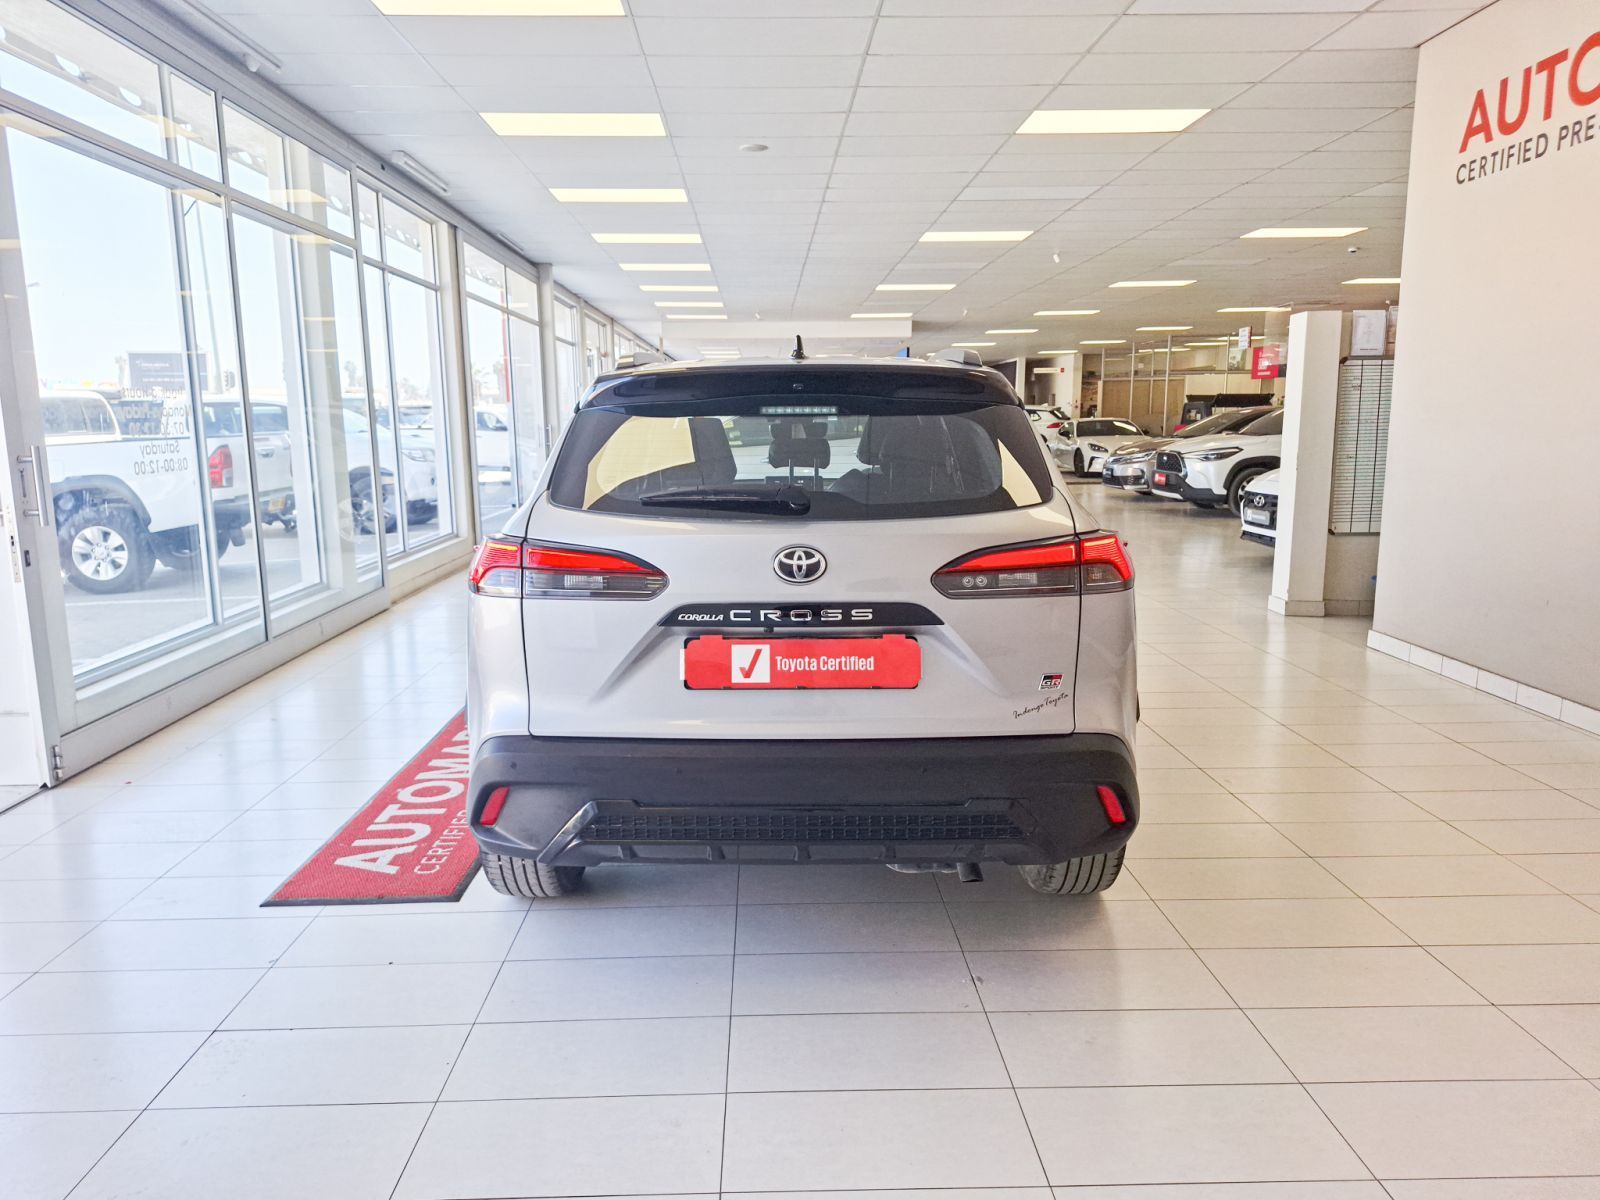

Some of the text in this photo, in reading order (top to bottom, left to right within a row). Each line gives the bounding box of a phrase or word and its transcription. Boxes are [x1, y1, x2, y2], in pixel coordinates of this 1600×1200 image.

[1456, 132, 1549, 185] CERTIFIED
[678, 609, 873, 622] COROLLA CROSS
[775, 655, 874, 673] Toyota Certified
[1045, 692, 1068, 707] Toyota
